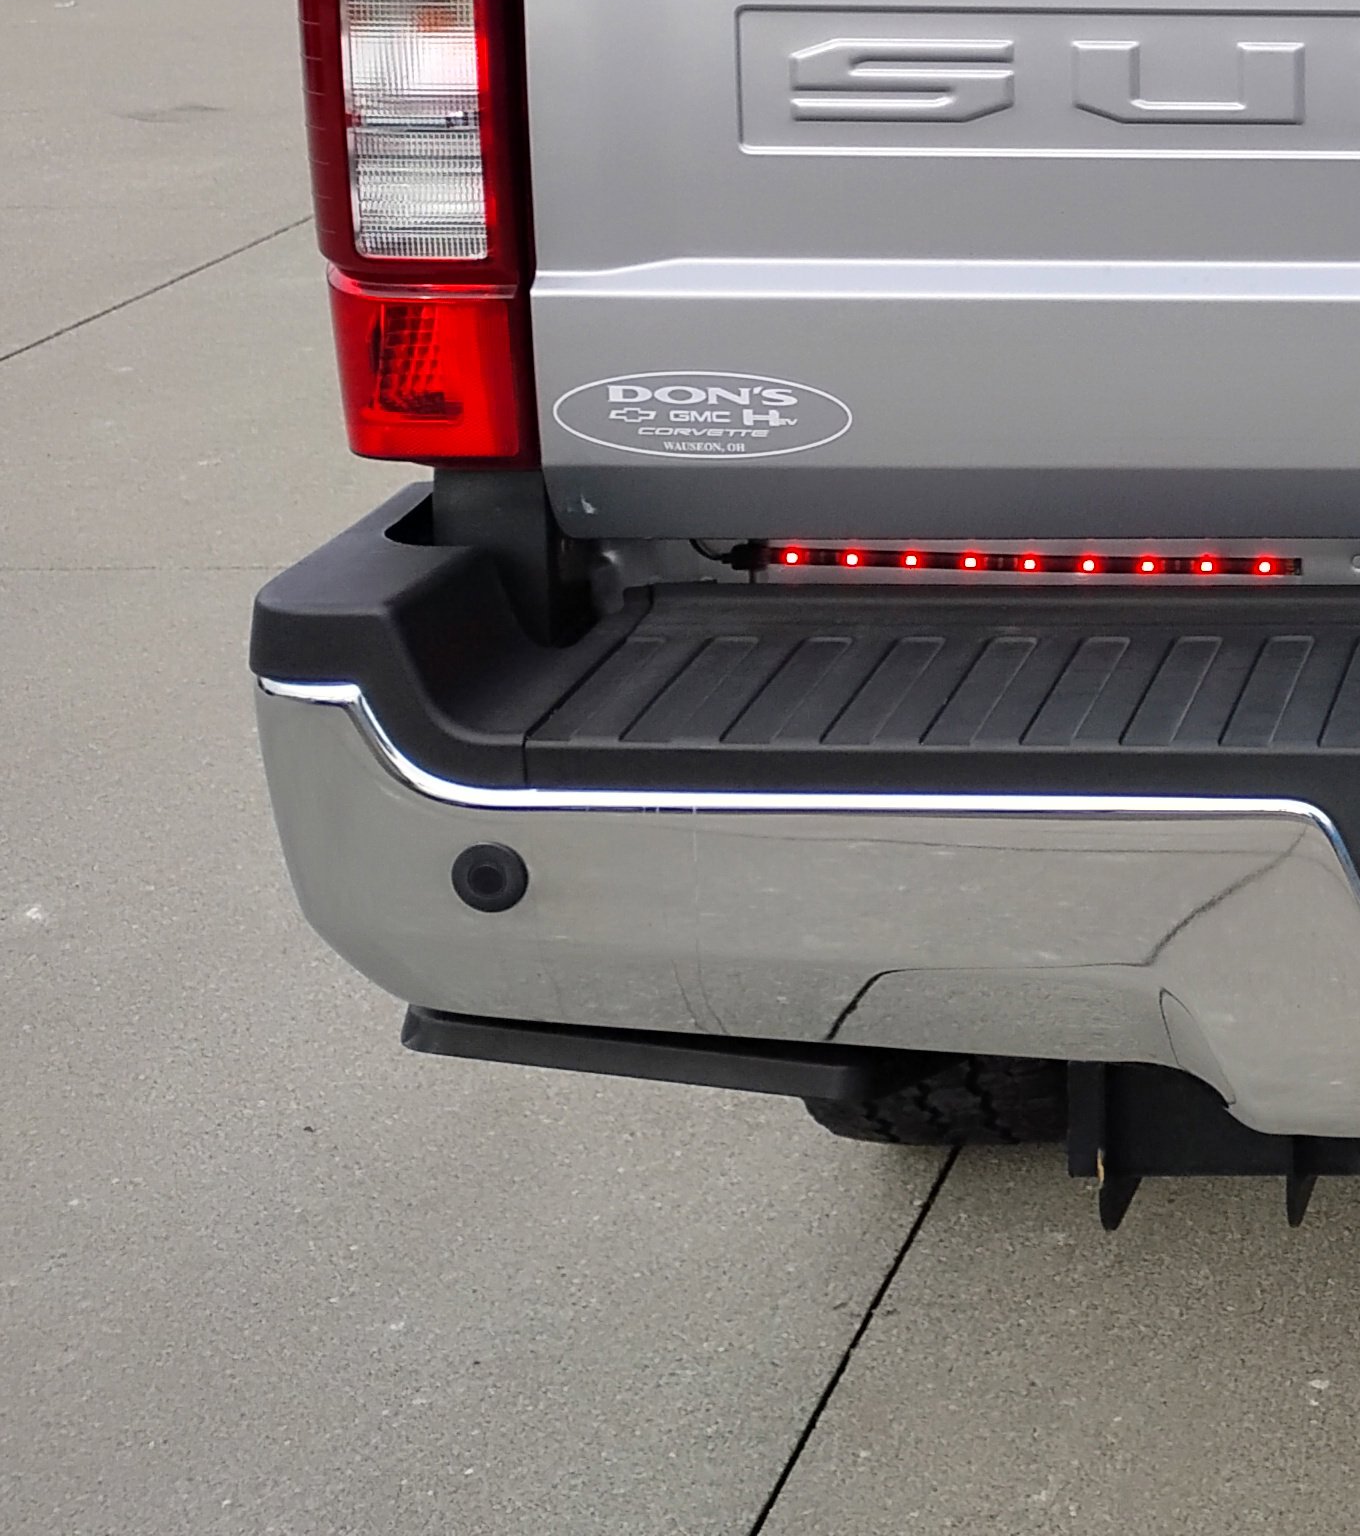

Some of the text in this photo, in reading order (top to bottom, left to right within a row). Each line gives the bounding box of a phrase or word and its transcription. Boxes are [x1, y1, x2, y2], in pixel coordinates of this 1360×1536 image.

[607, 385, 798, 406] DON'S
[669, 410, 731, 422] GMC
[638, 427, 769, 437] CORVETTE
[664, 441, 745, 452] WAUSEON, OH
